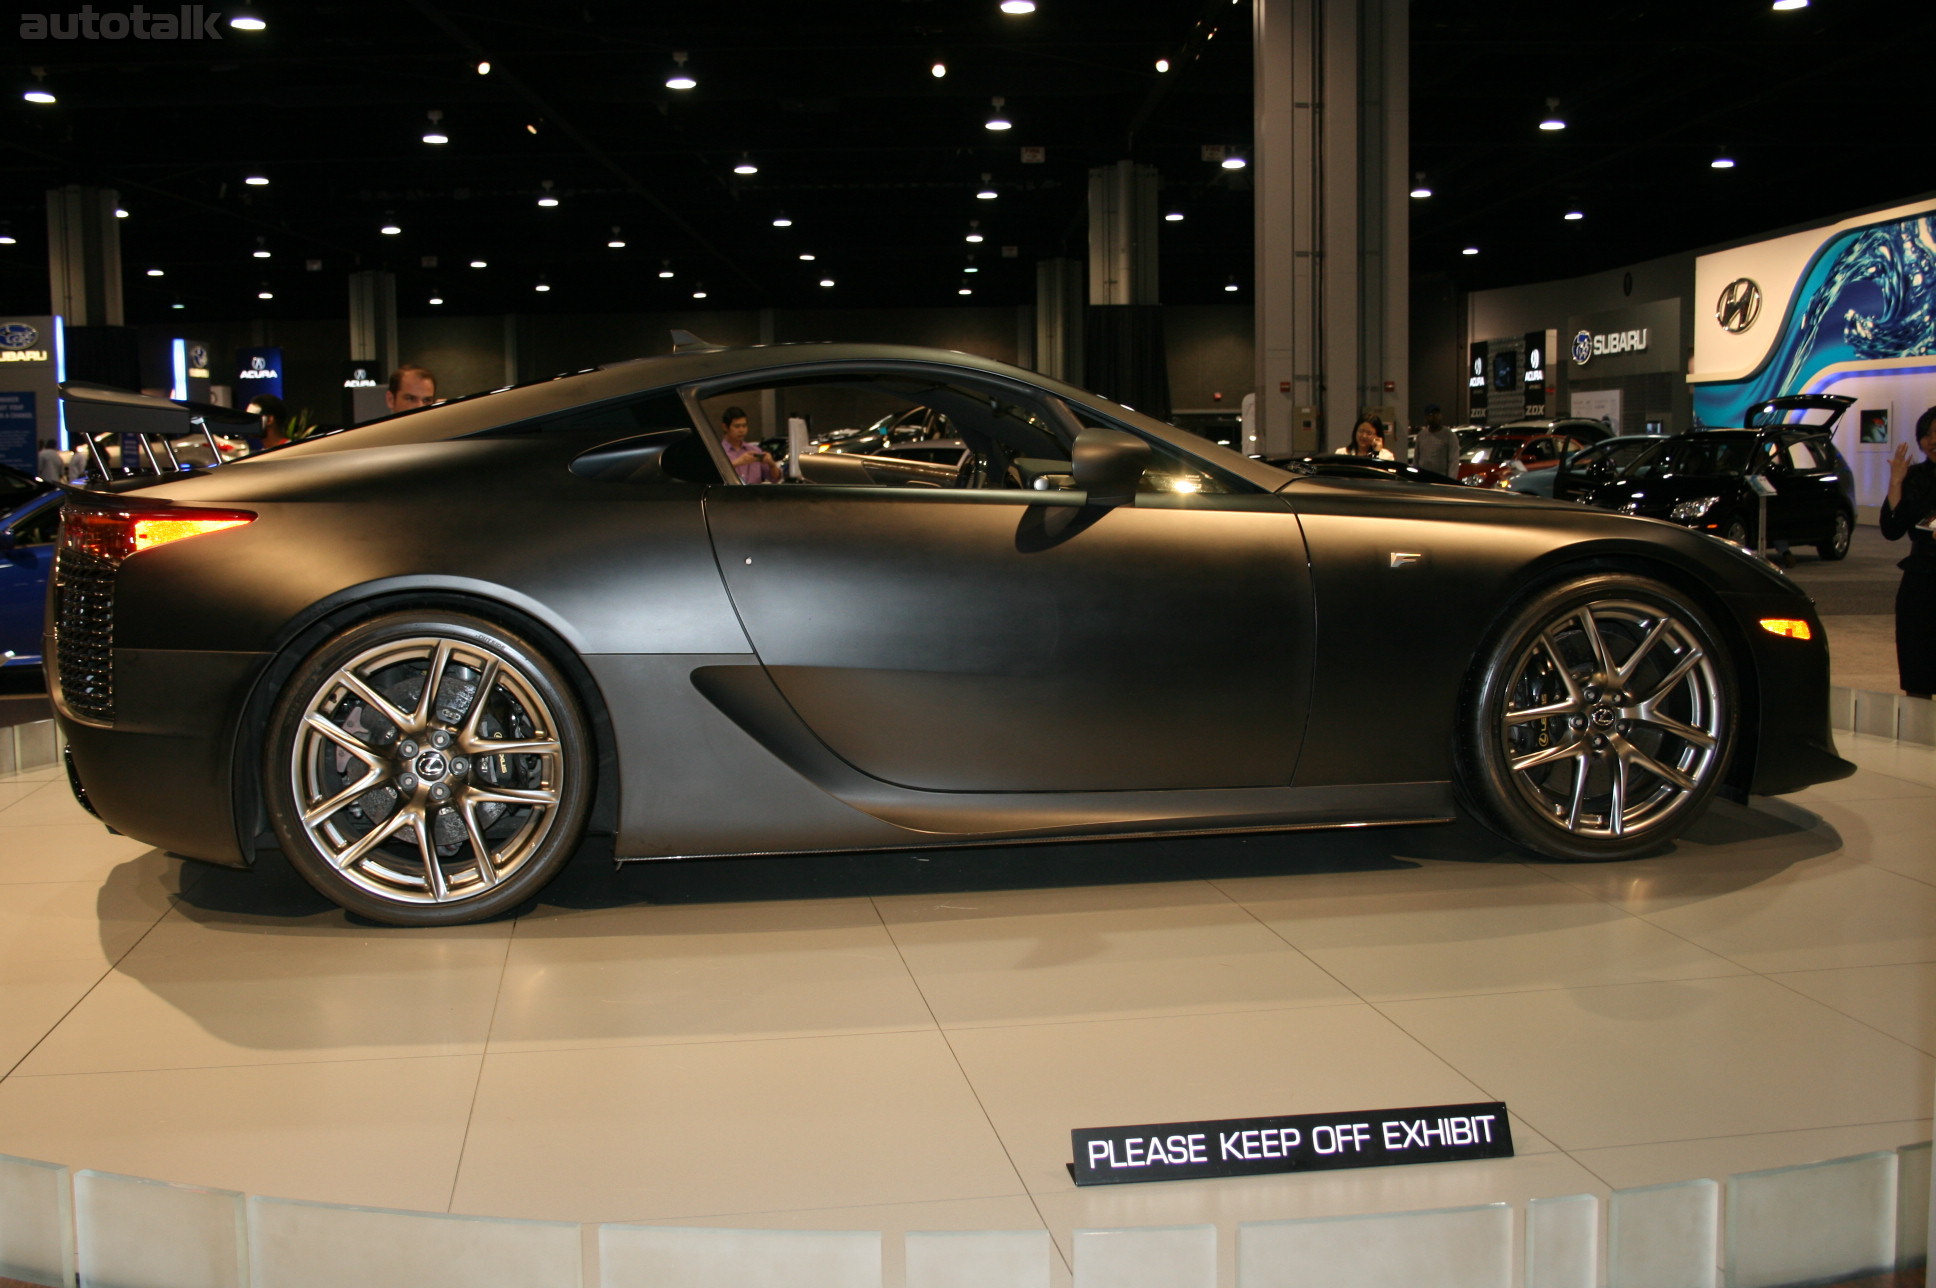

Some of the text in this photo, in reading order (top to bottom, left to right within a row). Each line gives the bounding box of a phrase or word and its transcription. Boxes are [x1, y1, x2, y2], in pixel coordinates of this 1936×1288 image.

[1593, 328, 1648, 355] SUBARU
[0, 350, 48, 362] UBARU
[239, 369, 278, 379] ACURA
[1524, 370, 1544, 382] ACURA
[1469, 376, 1485, 387] ACURA
[1470, 409, 1486, 418] ZDX
[1525, 405, 1545, 416] ZDX
[1087, 1114, 1496, 1169] PLEASE KEEP OFF EXHIBIT
